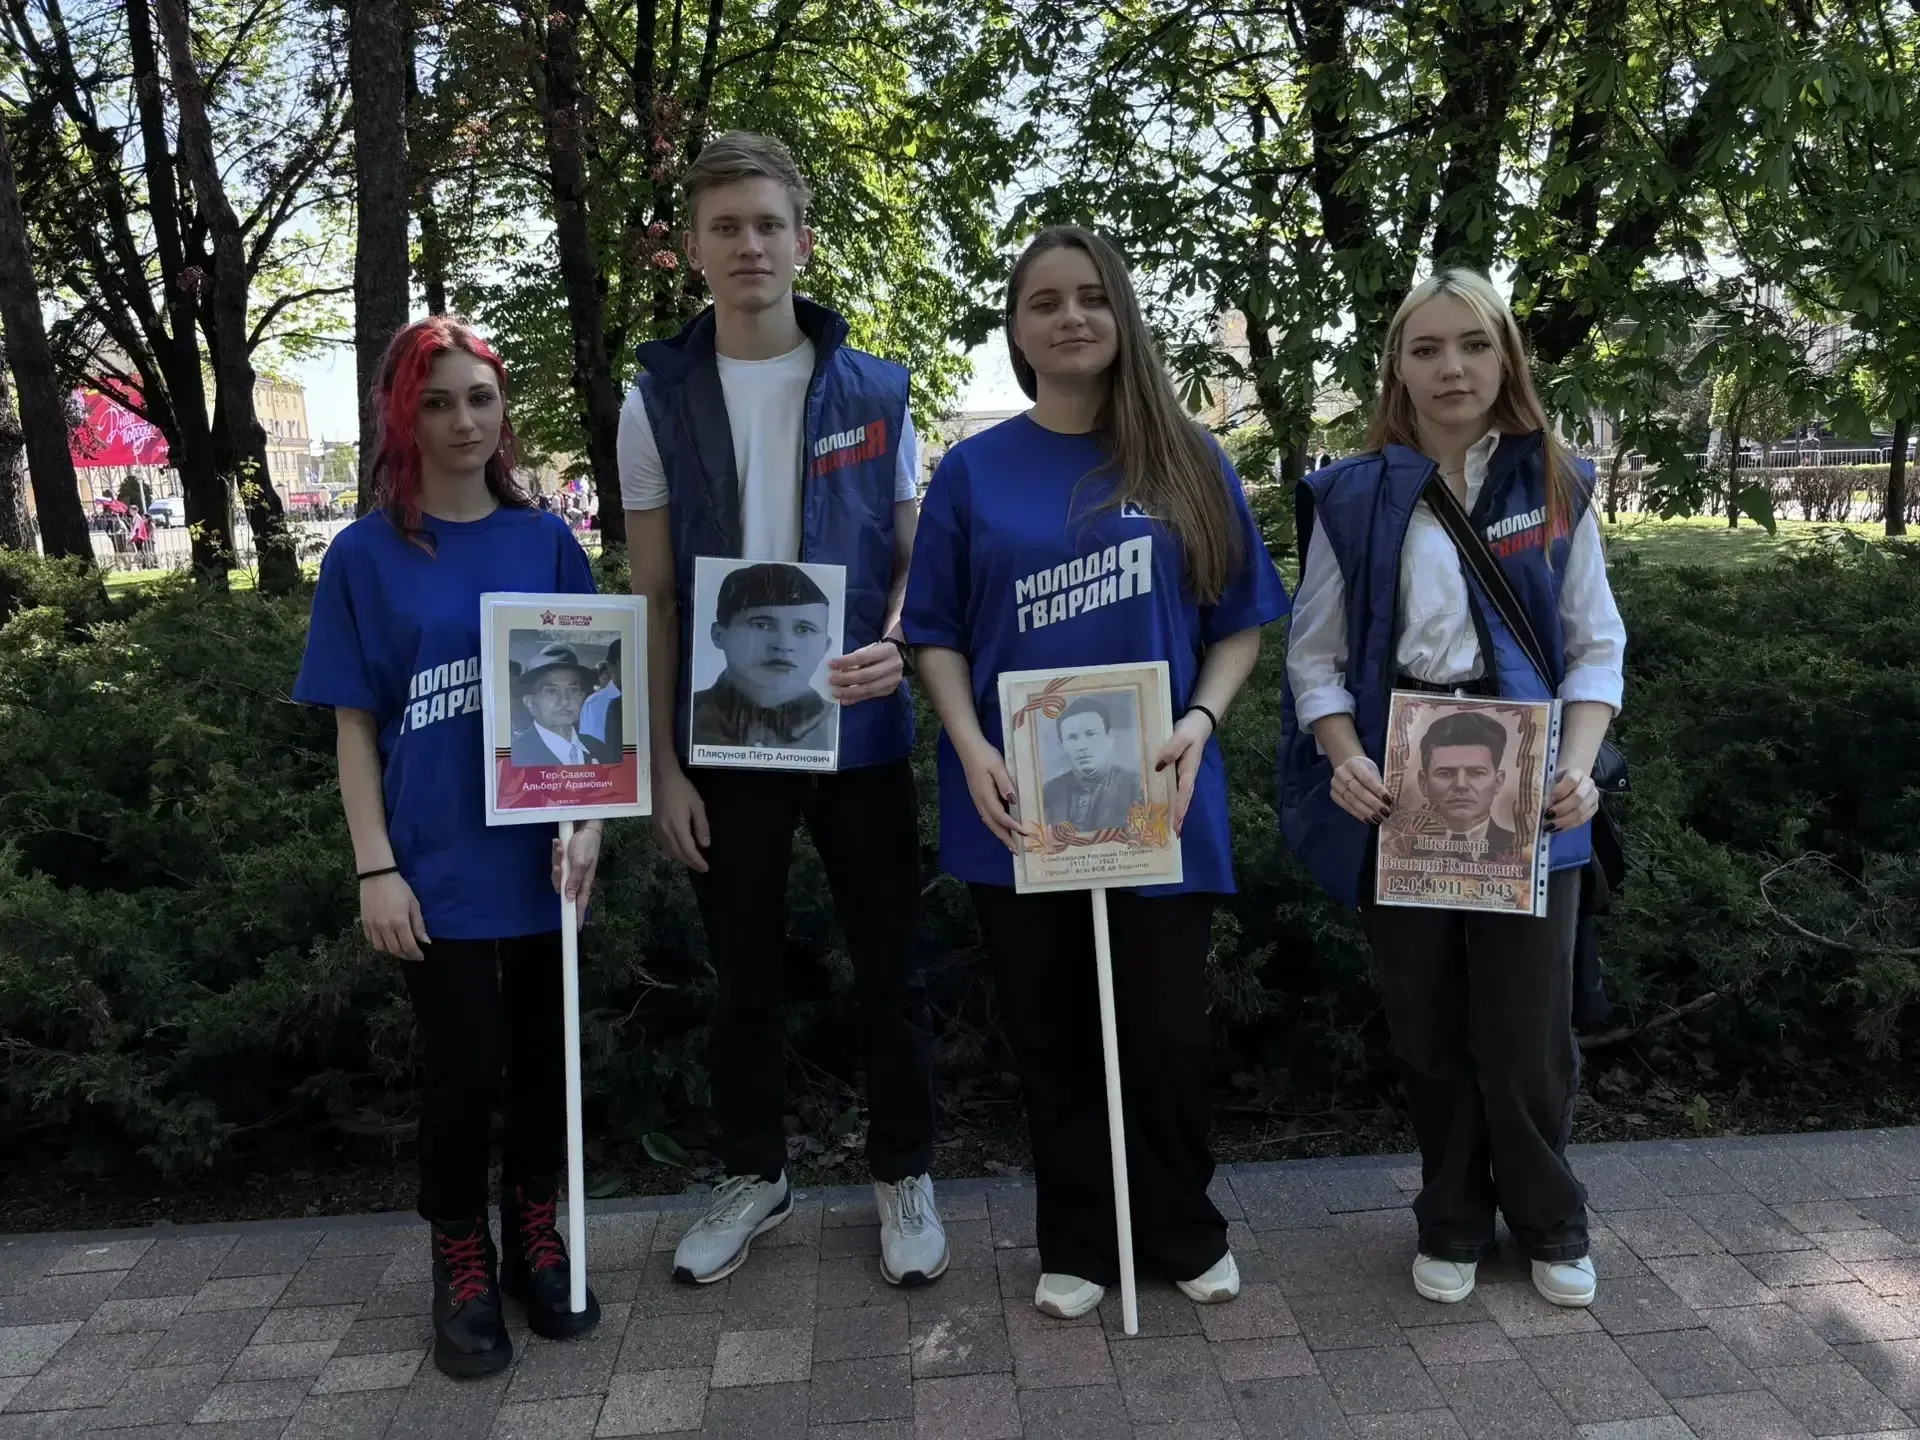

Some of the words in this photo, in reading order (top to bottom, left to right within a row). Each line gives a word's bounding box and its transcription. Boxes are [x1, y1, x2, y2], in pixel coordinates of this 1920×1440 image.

[400, 684, 483, 735] ГВАРД
[698, 748, 746, 760] Плясунов
[749, 750, 773, 761] Пётр
[775, 752, 830, 763] Антонович
[540, 770, 596, 780] Тер-Сааков
[522, 782, 562, 791] Альберт
[565, 780, 613, 789] Арамович
[1414, 835, 1489, 854] Лисицкий
[1381, 855, 1442, 872] Василий
[1446, 859, 1523, 877] Климович
[1387, 876, 1461, 895] 12.04.1911
[1479, 882, 1513, 899] 1943
